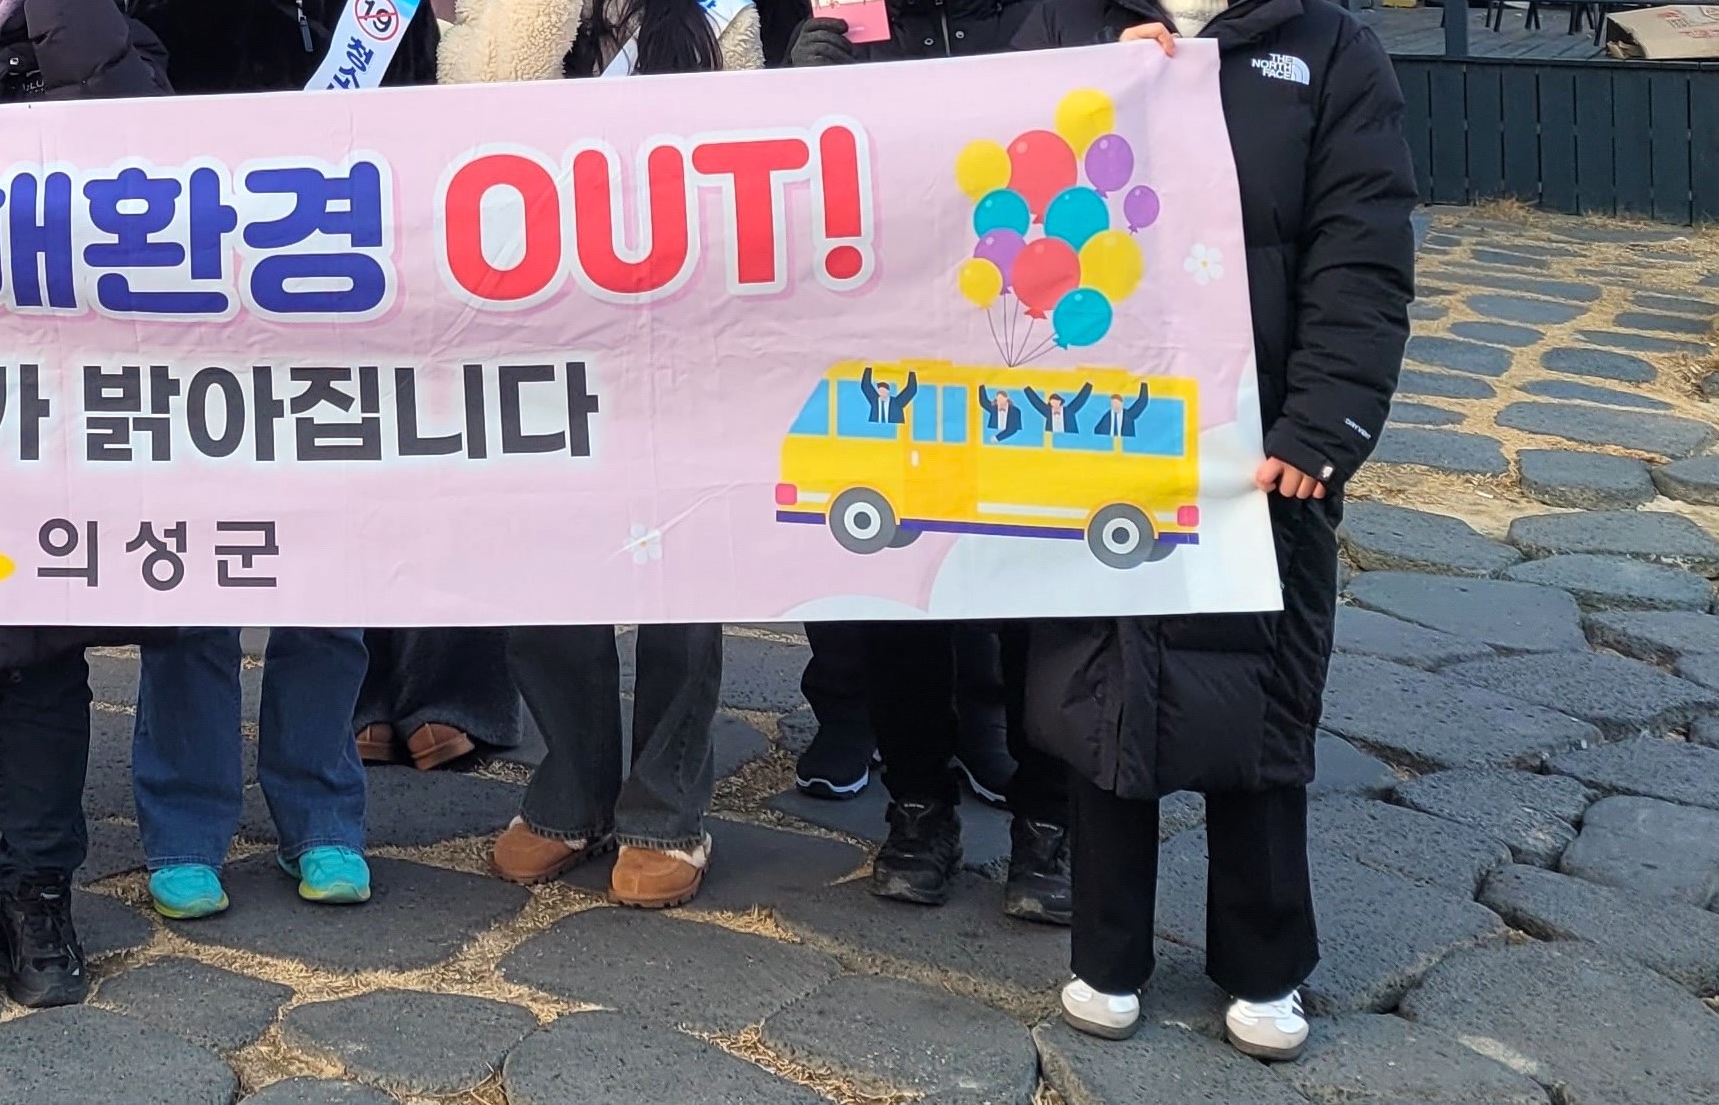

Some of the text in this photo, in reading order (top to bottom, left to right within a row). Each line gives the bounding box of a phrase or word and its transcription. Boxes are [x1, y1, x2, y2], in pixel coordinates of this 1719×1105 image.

[364, 0, 393, 33] 19
[326, 36, 375, 90] 청소
[1251, 58, 1292, 73] NORTH
[1262, 68, 1292, 81] FACE
[1269, 53, 1294, 63] THE
[444, 124, 864, 302] OUT!
[81, 360, 599, 461] 밝아집니다
[37, 517, 280, 590] 의성군
